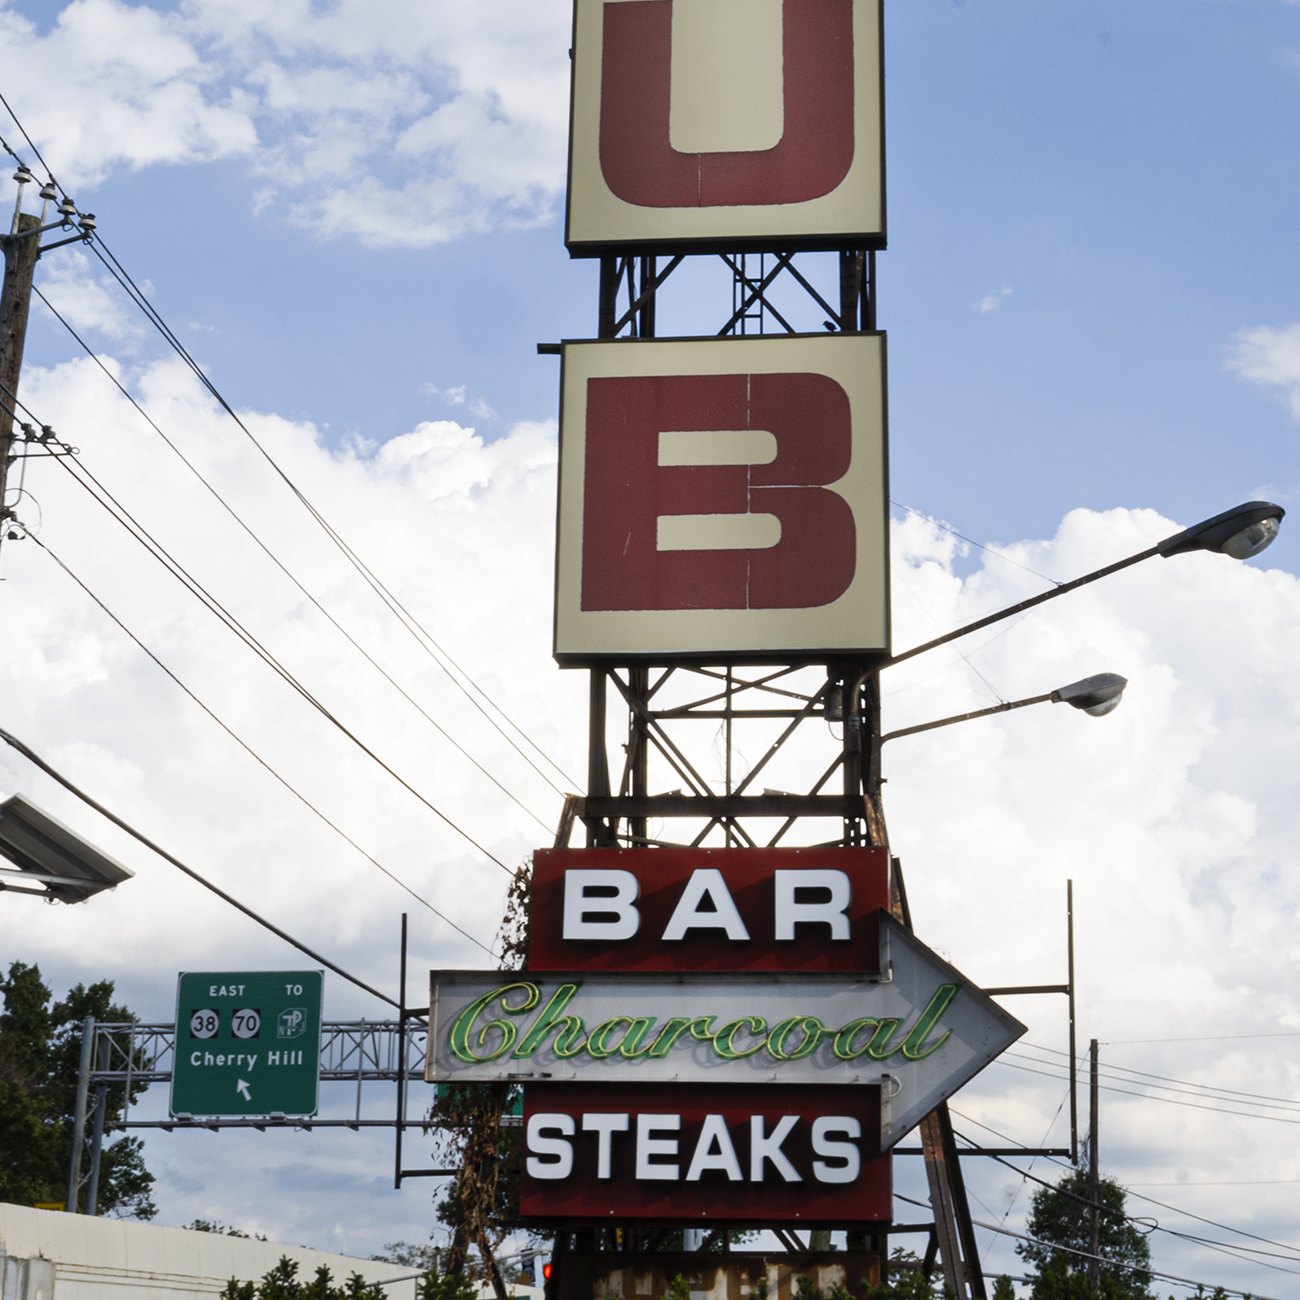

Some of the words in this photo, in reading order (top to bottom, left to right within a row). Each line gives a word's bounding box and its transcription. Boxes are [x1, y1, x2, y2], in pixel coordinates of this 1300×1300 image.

[561, 868, 852, 941] BAR
[209, 985, 245, 997] EAST
[285, 984, 303, 996] TO
[193, 1015, 216, 1032] 38
[234, 1015, 257, 1032] 70
[448, 981, 962, 1064] Charcoal
[190, 1051, 258, 1072] Cherry
[267, 1050, 303, 1066] Hill
[525, 1112, 862, 1184] STEAKS
